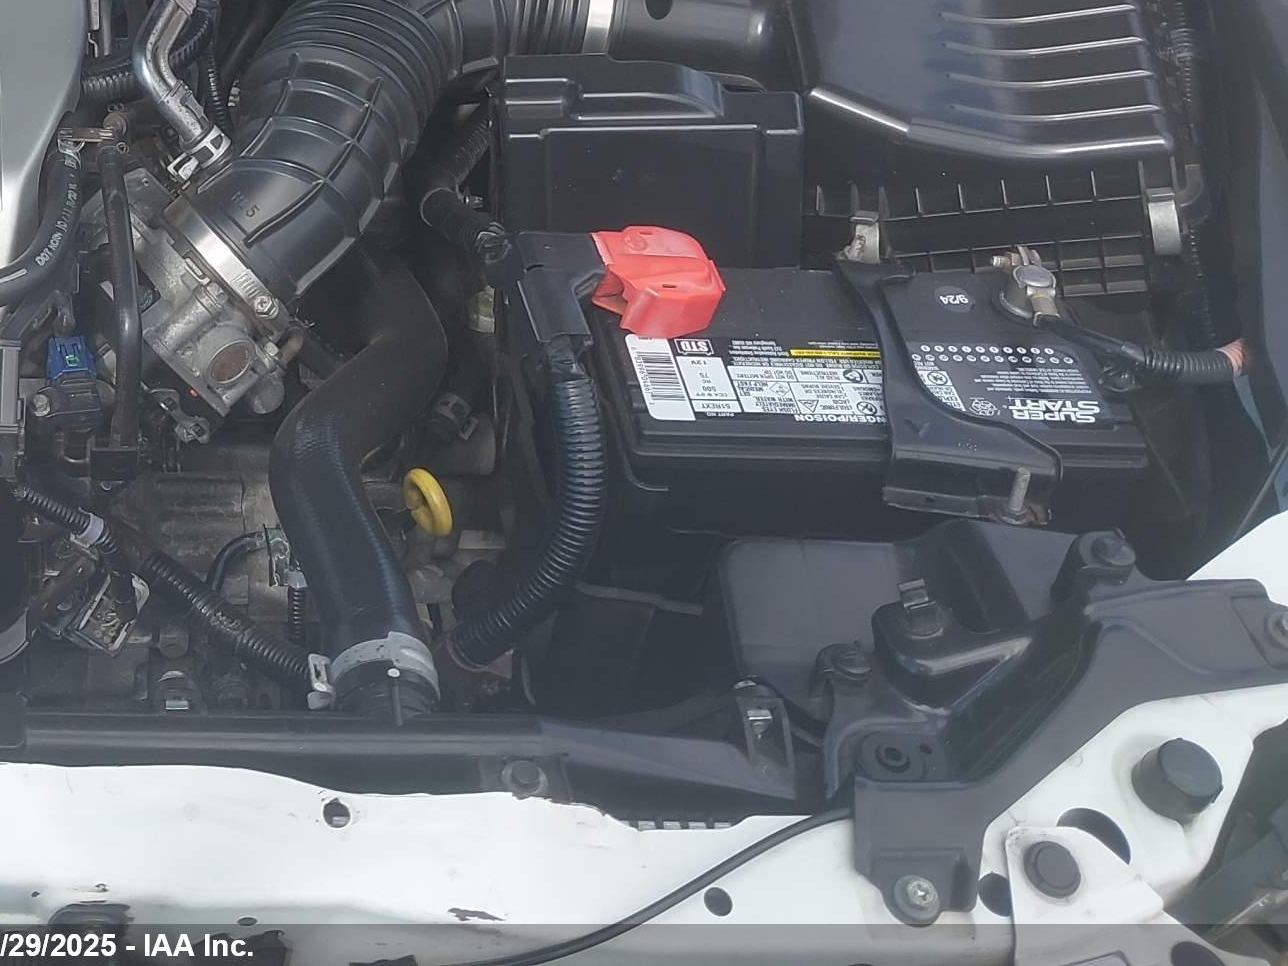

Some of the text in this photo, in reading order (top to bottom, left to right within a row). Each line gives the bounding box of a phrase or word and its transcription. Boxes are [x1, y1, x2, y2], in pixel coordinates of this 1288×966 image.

[939, 294, 969, 305] 9/24
[680, 341, 709, 353] STD
[1008, 400, 1100, 414] START
[1011, 410, 1096, 423] SUPER
